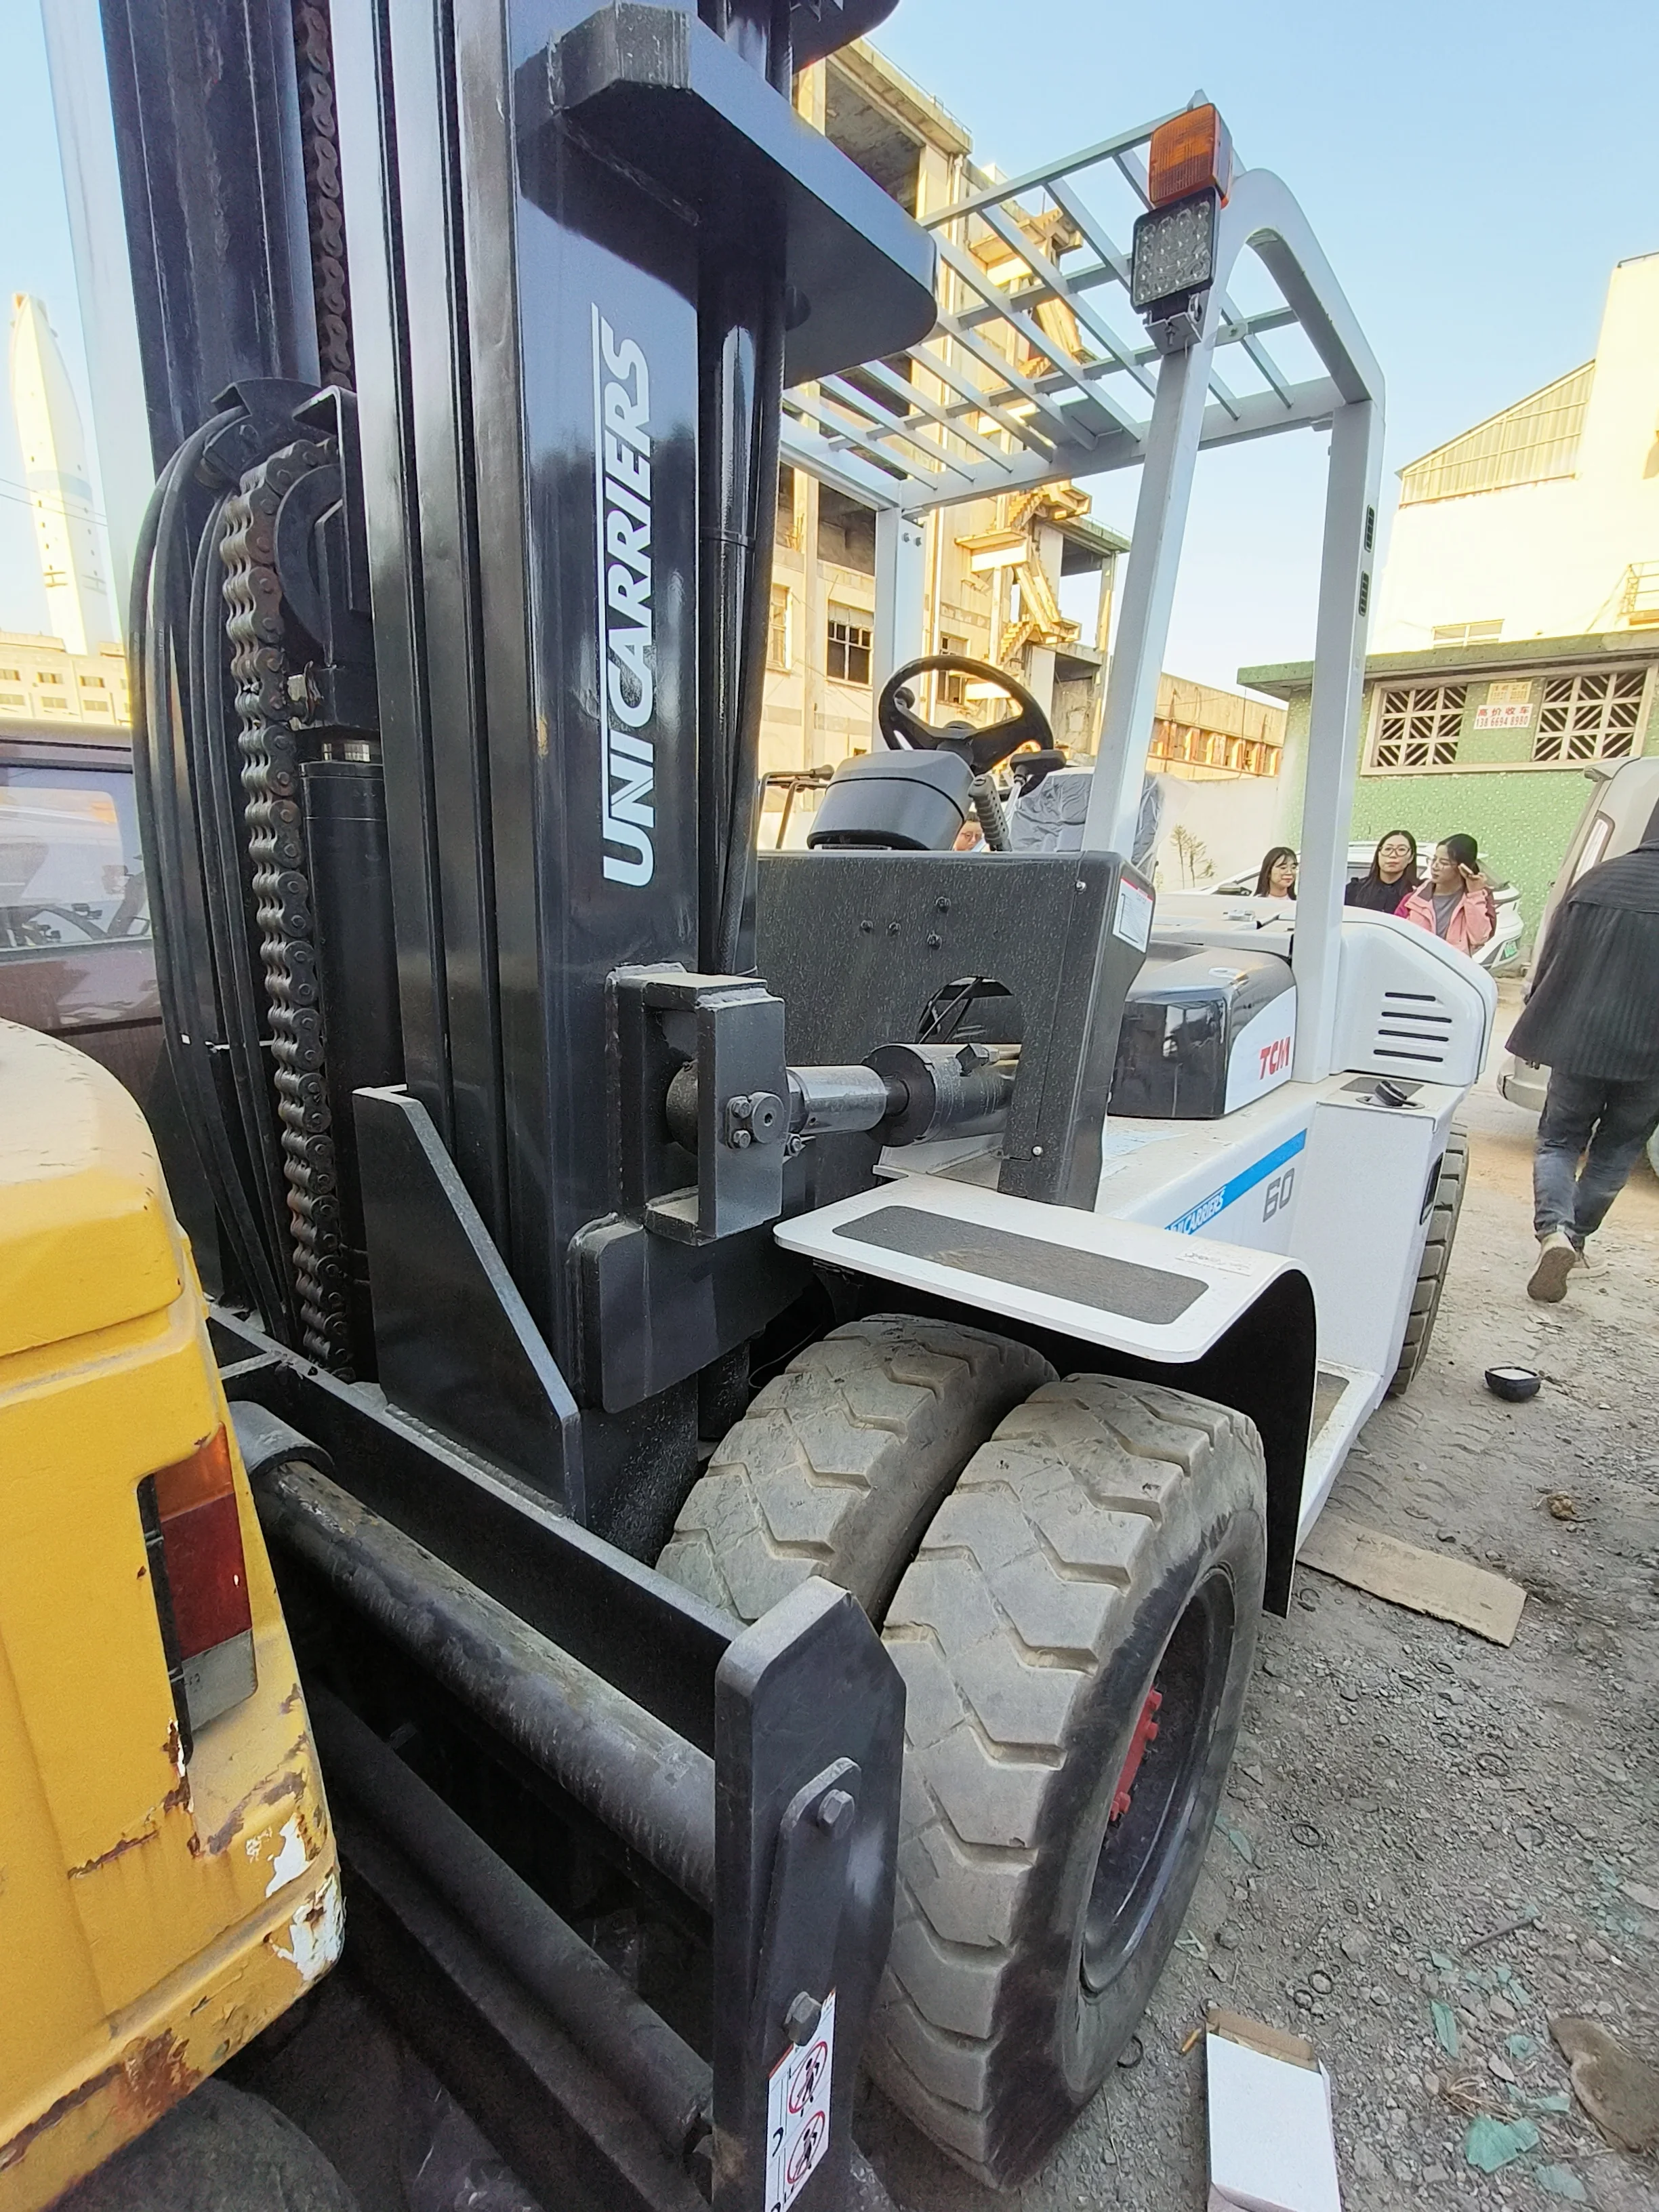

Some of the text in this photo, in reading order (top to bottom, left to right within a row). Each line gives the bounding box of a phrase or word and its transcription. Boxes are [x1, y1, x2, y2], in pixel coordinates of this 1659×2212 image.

[594, 303, 654, 888] UNICARRIERS
[1478, 706, 1530, 716] 高价收车
[1259, 1037, 1290, 1080] TCM
[1263, 1168, 1295, 1223] 60
